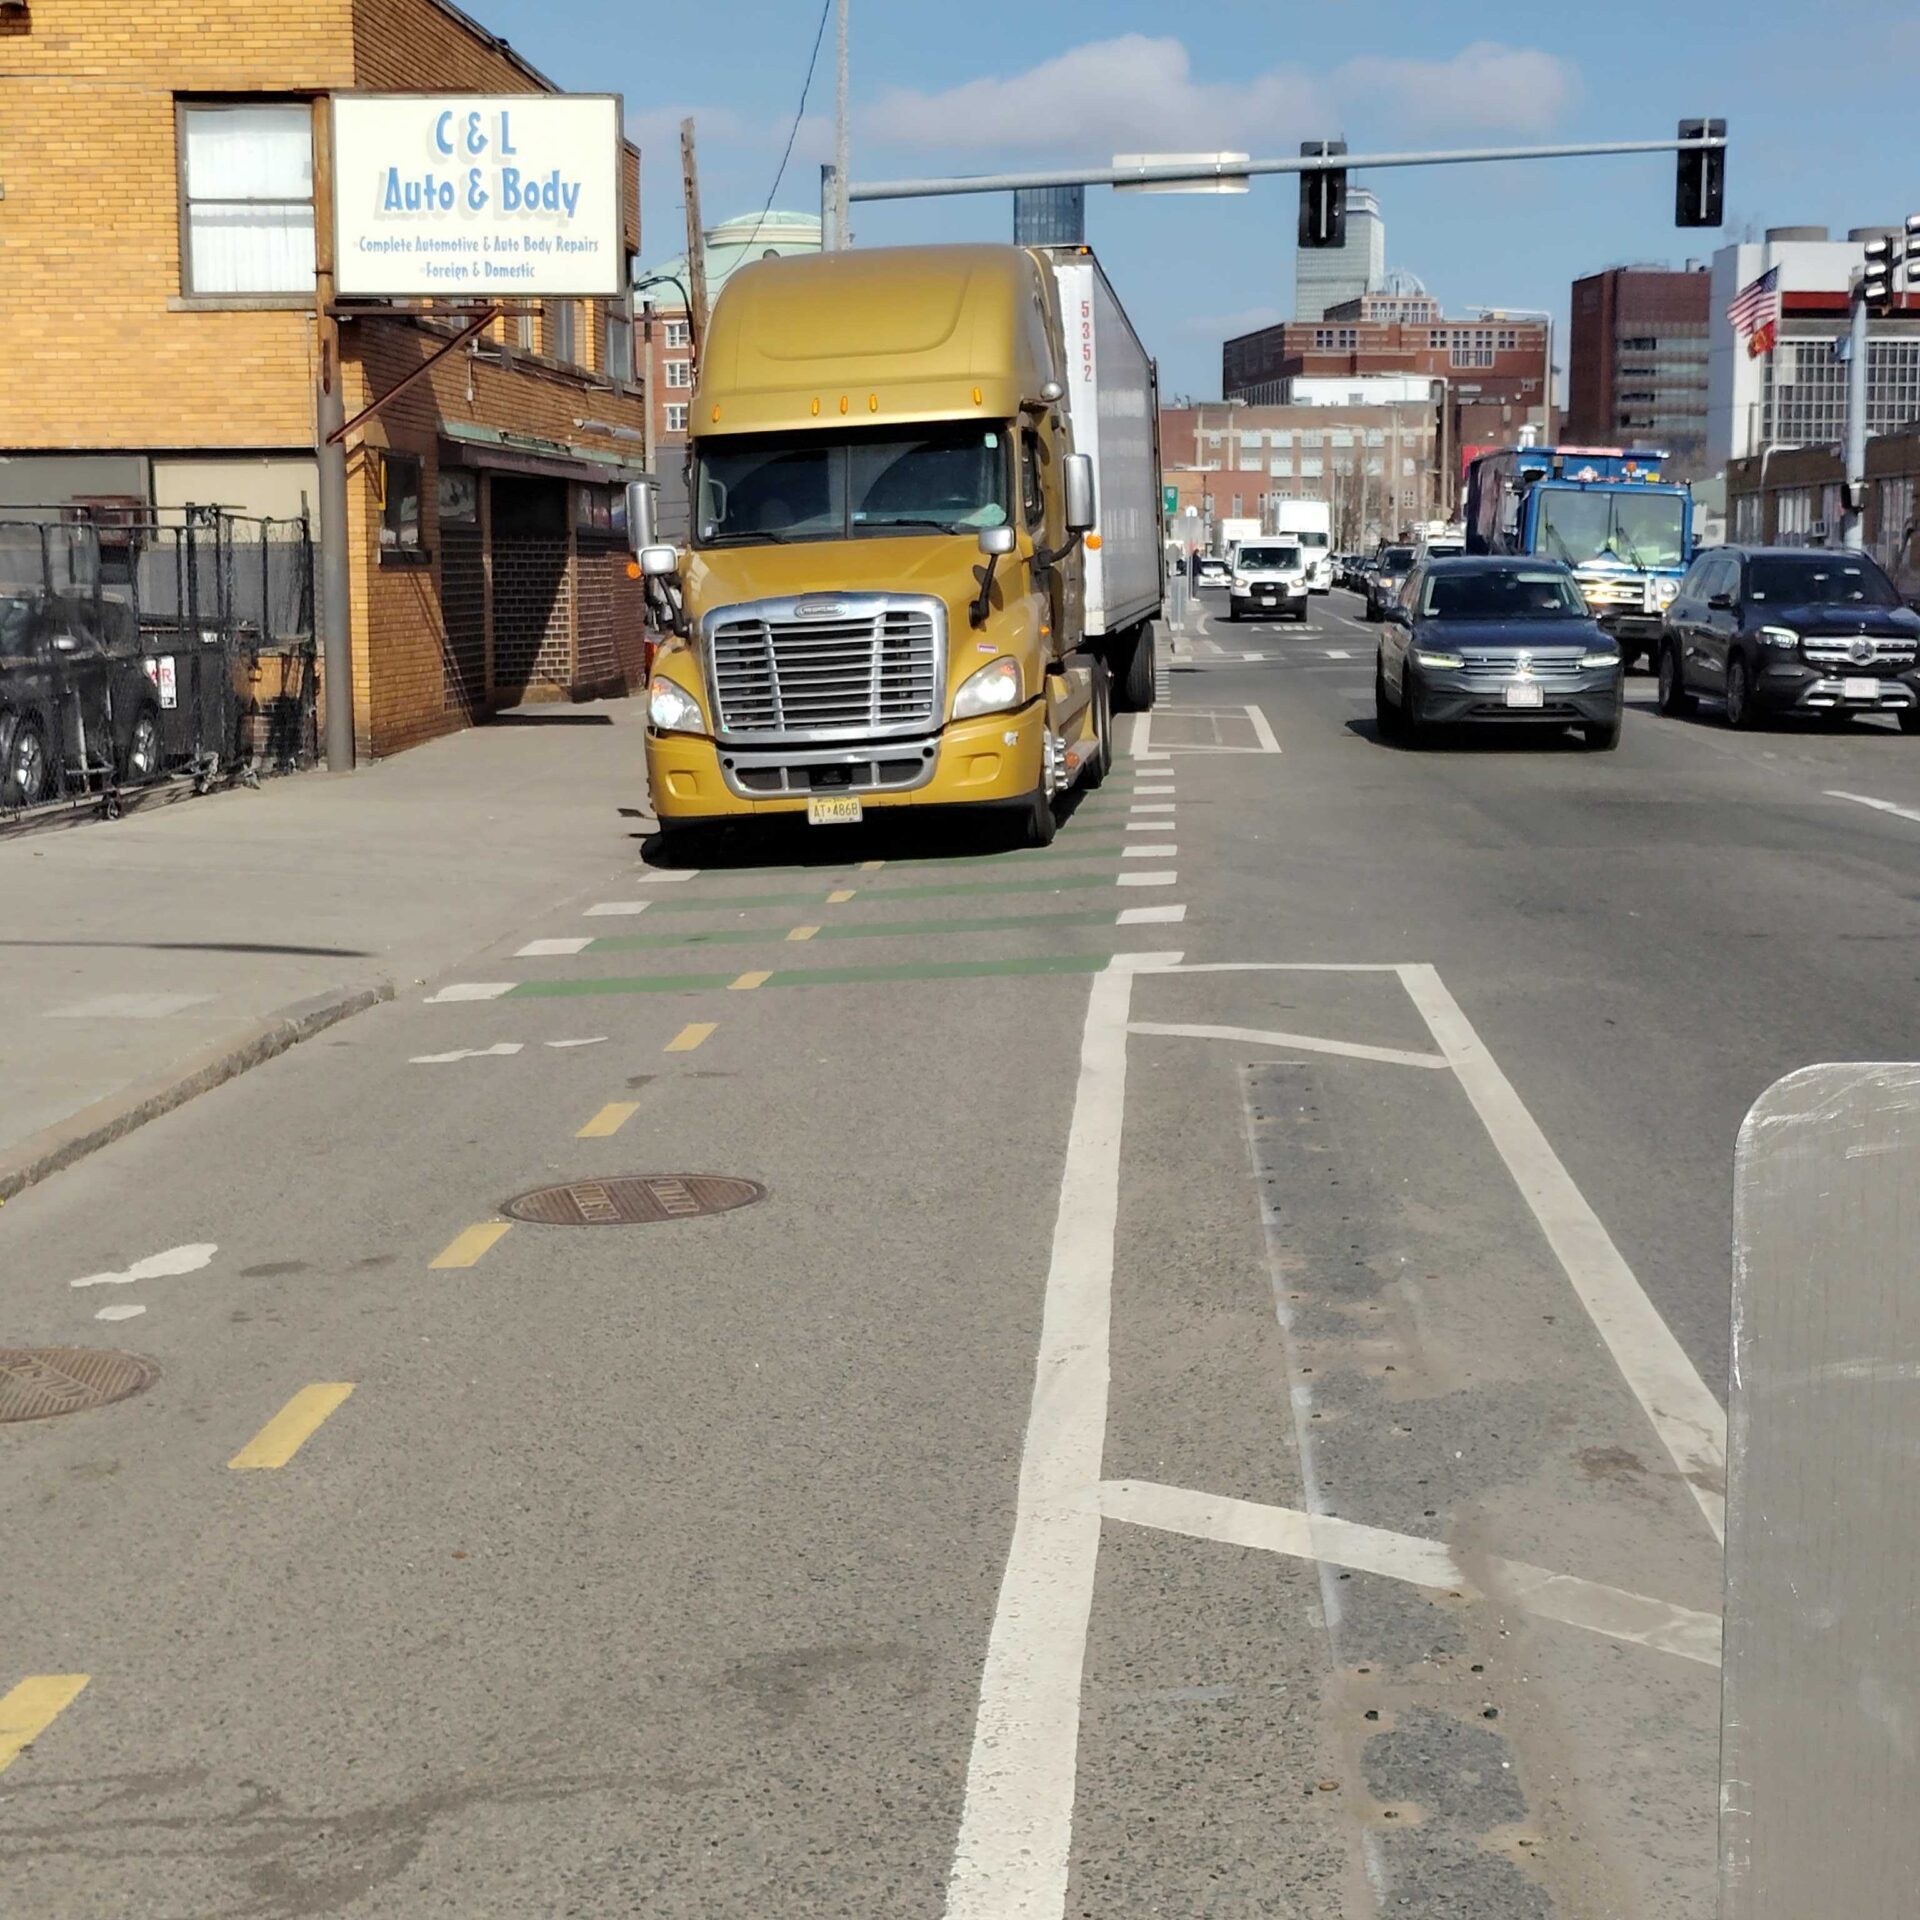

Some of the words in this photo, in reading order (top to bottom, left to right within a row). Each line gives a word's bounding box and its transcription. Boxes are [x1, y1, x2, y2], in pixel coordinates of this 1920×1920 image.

[435, 110, 454, 155] C
[466, 111, 488, 155] &
[500, 110, 517, 155] L
[384, 166, 455, 211] Auto
[467, 167, 489, 211] &
[501, 167, 581, 218] Body
[359, 235, 413, 254] Complete
[415, 235, 479, 252] Automotive
[483, 235, 492, 252] &
[493, 235, 520, 252] Auto
[523, 235, 553, 255] Body
[555, 235, 599, 254] Repairs
[426, 261, 469, 281] Foreign
[472, 261, 481, 278] &
[484, 260, 535, 279] Domestic
[1081, 300, 1092, 383] 5352
